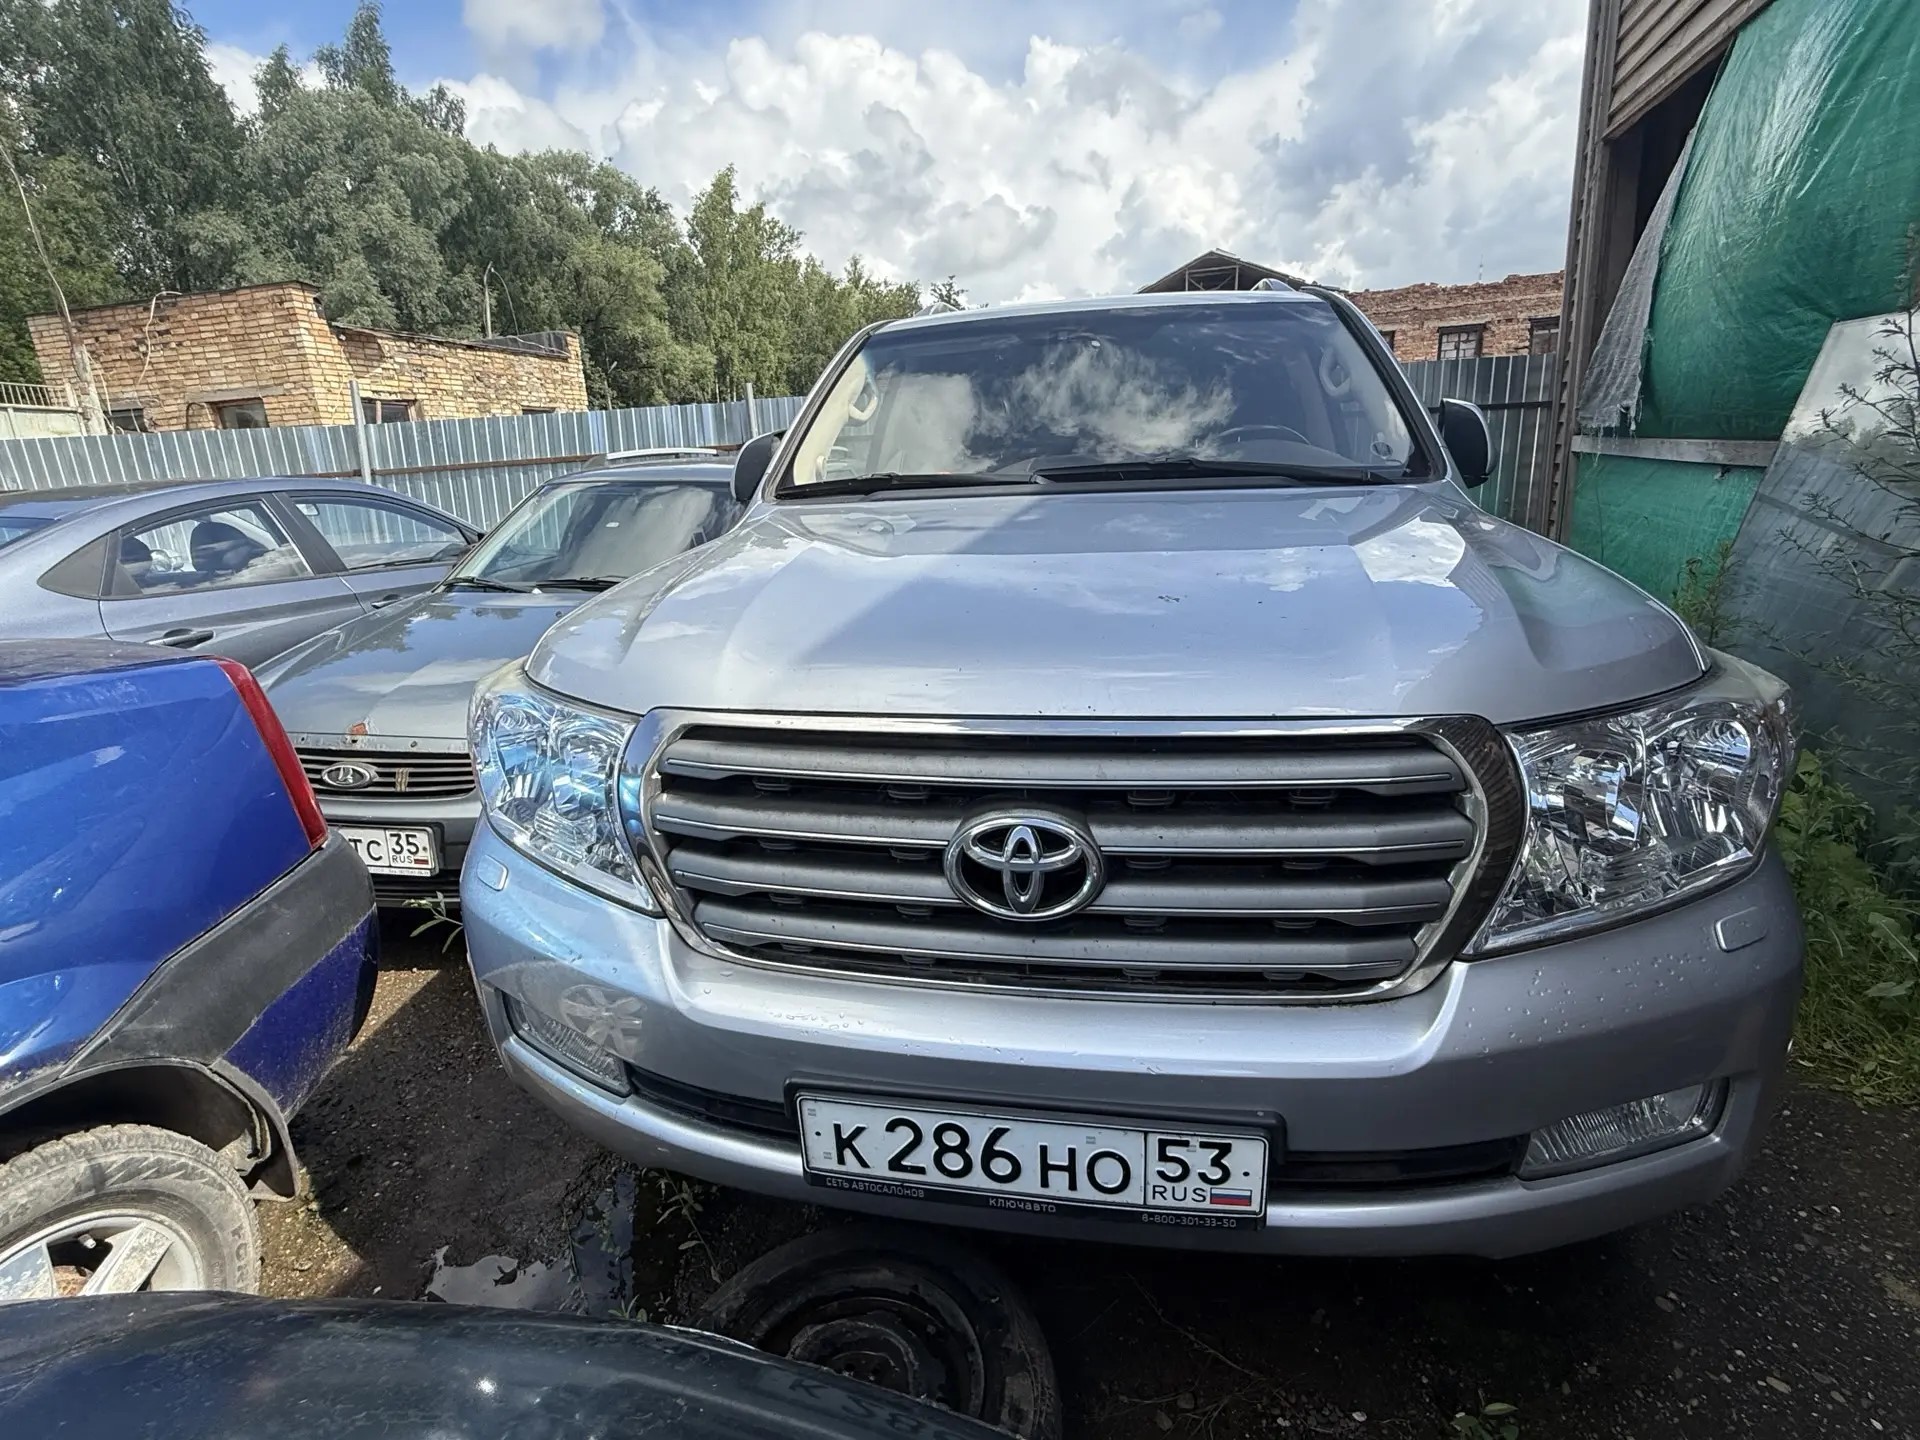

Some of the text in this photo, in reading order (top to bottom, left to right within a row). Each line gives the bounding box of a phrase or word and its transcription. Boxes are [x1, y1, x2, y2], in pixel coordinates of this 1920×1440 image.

[389, 833, 420, 855] 35
[391, 854, 413, 864] RUS
[1155, 1137, 1233, 1186] 53
[825, 1177, 925, 1198] СЕТЬ АВТОСАЛОНОВ
[1151, 1184, 1207, 1203] RUS
[1141, 1213, 1237, 1228] 8-800-301-33-50
